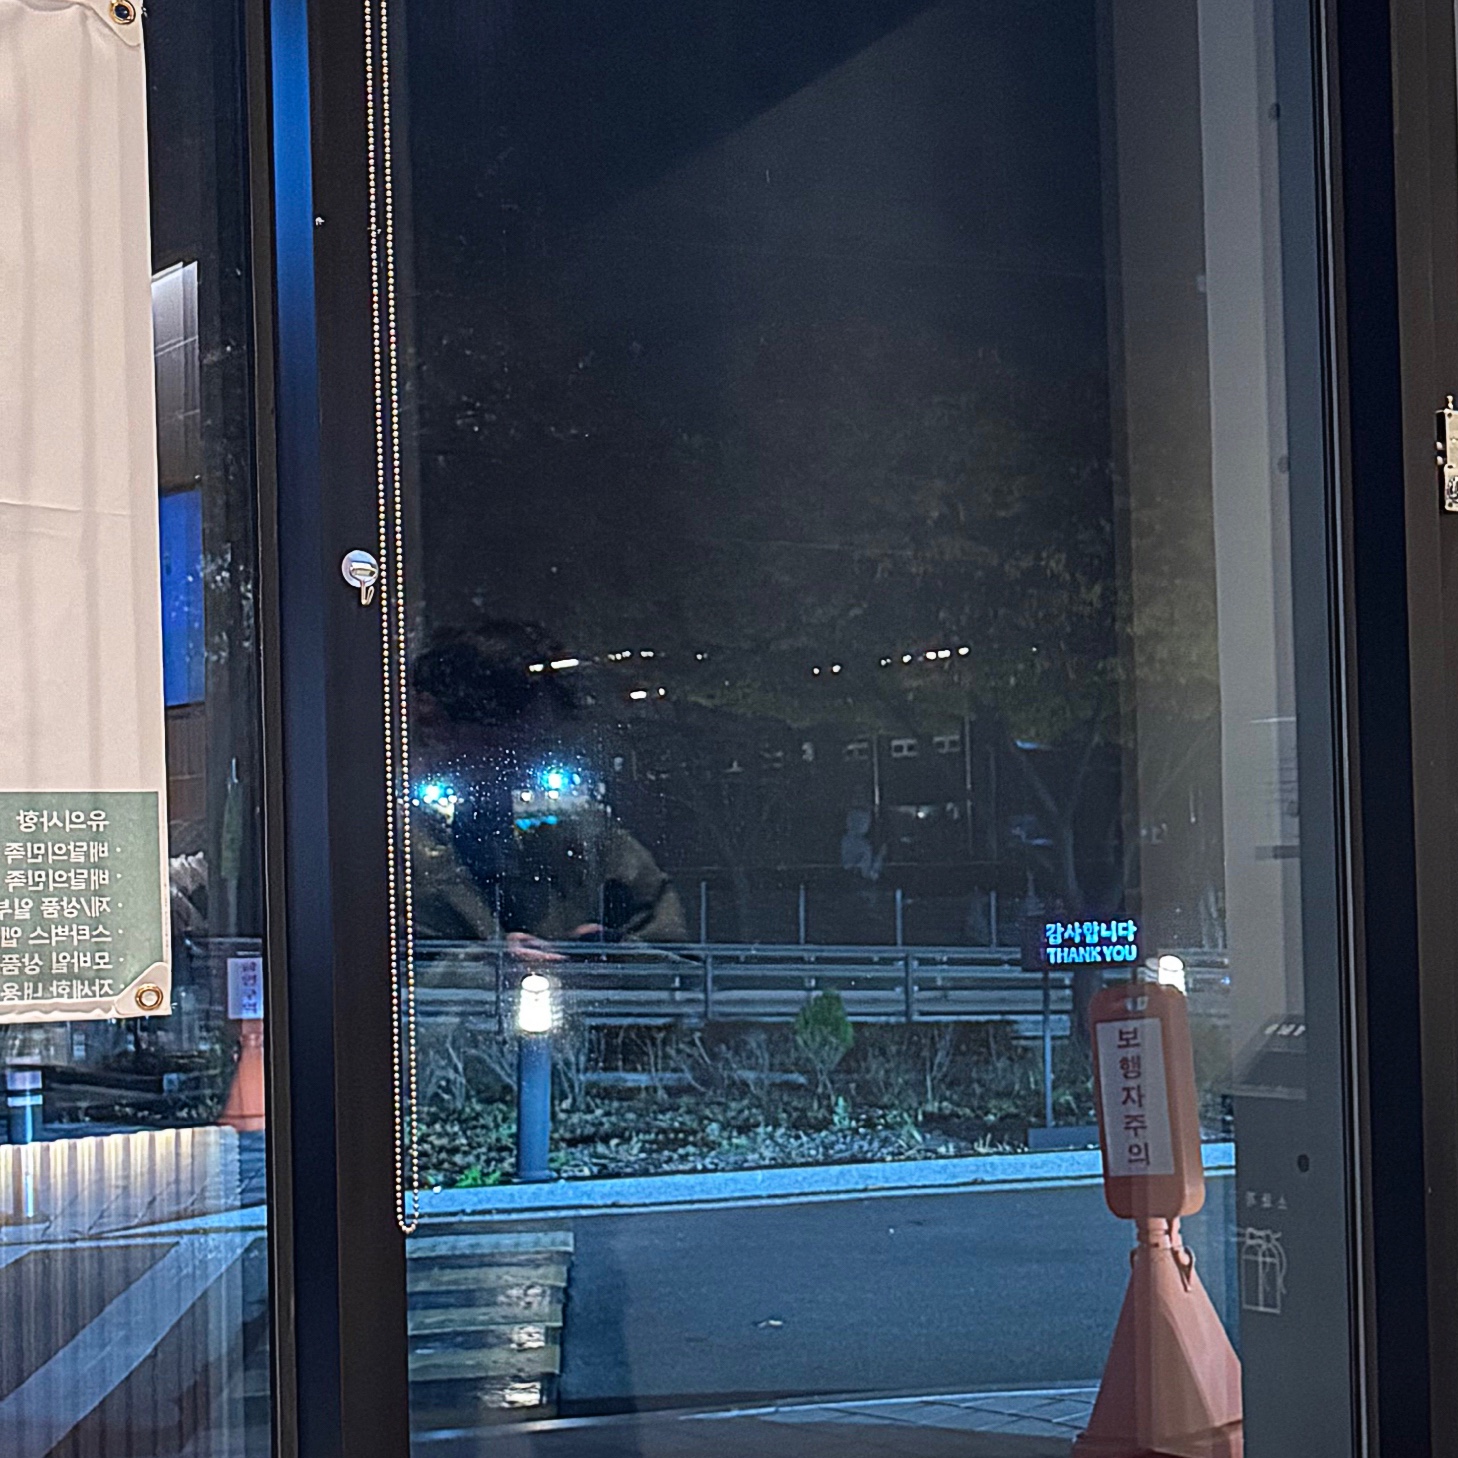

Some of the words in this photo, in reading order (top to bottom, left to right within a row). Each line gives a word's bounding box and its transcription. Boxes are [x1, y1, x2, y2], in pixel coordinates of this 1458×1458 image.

[1046, 920, 1137, 944] 감사합니다
[1046, 946, 1101, 964] THANK
[1101, 944, 1137, 962] YOU
[1117, 1028, 1150, 1166] 보행자주의
